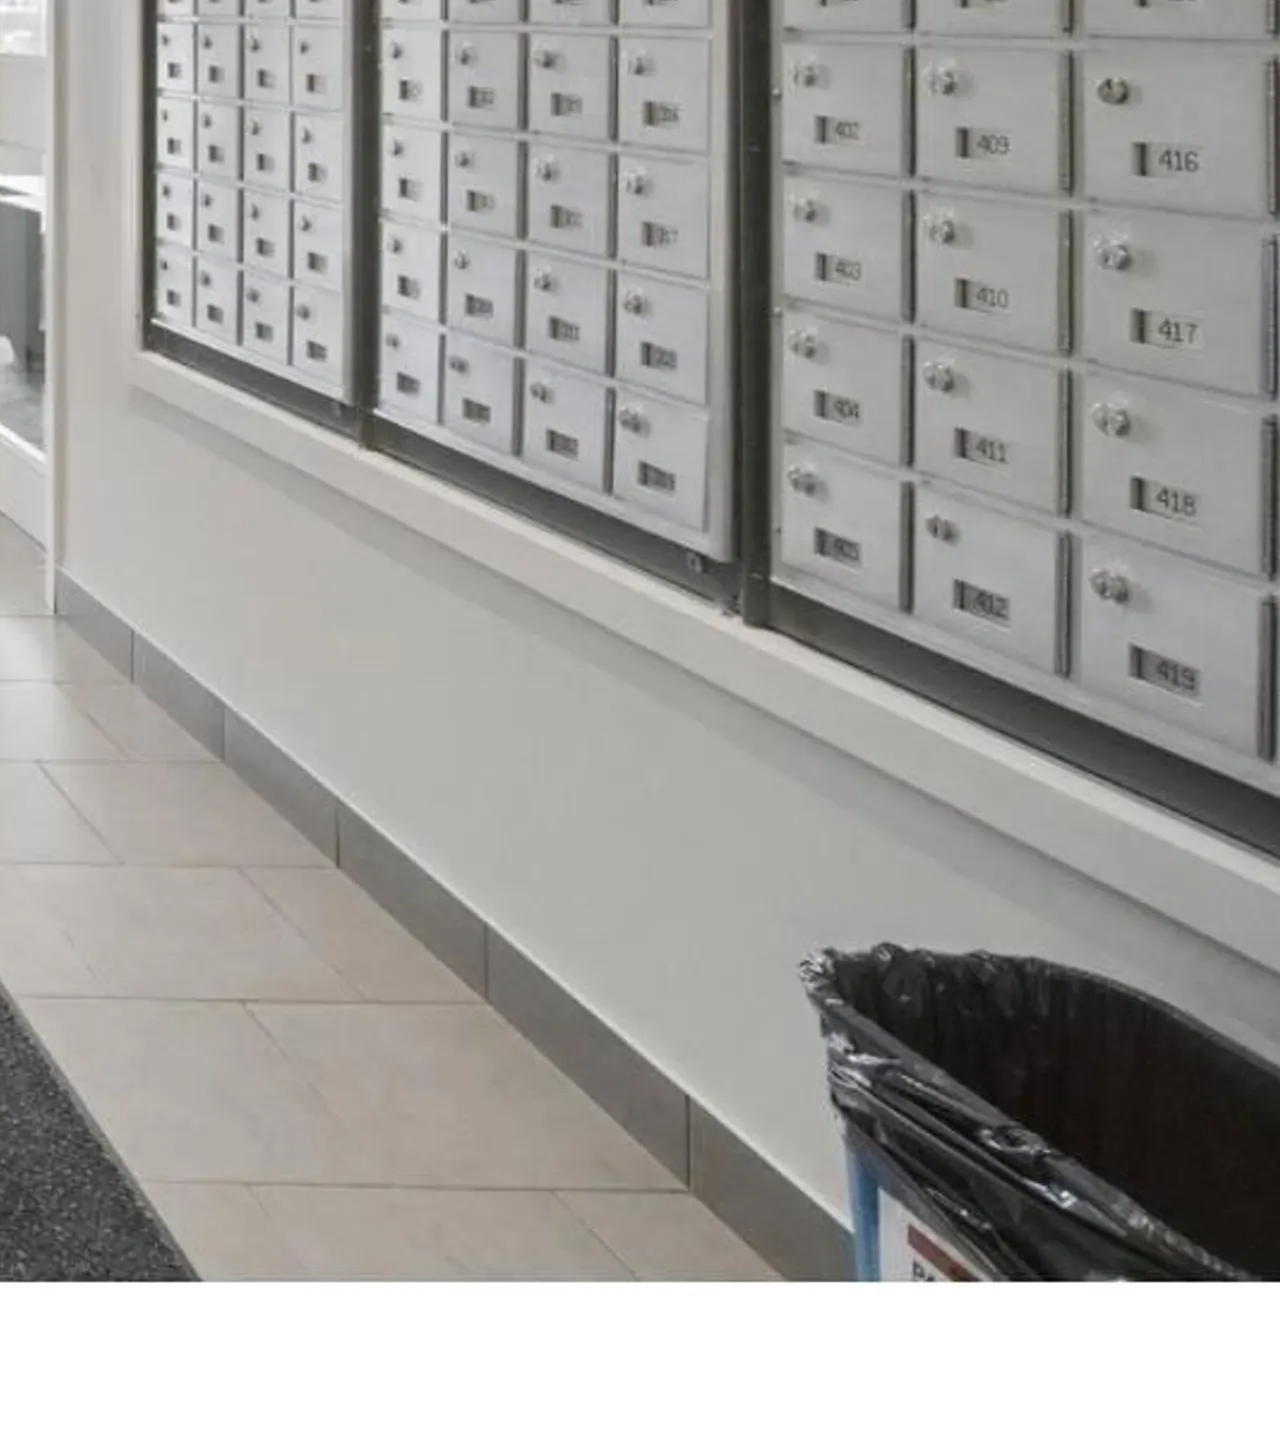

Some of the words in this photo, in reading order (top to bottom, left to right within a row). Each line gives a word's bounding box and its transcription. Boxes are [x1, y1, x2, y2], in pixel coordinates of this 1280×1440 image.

[1158, 149, 1198, 173] 416
[976, 287, 1010, 309] 410
[1158, 318, 1199, 345] 417
[976, 437, 1007, 463] 411
[1156, 487, 1197, 518] 418
[976, 590, 1010, 619] 412
[1155, 659, 1196, 691] 419
